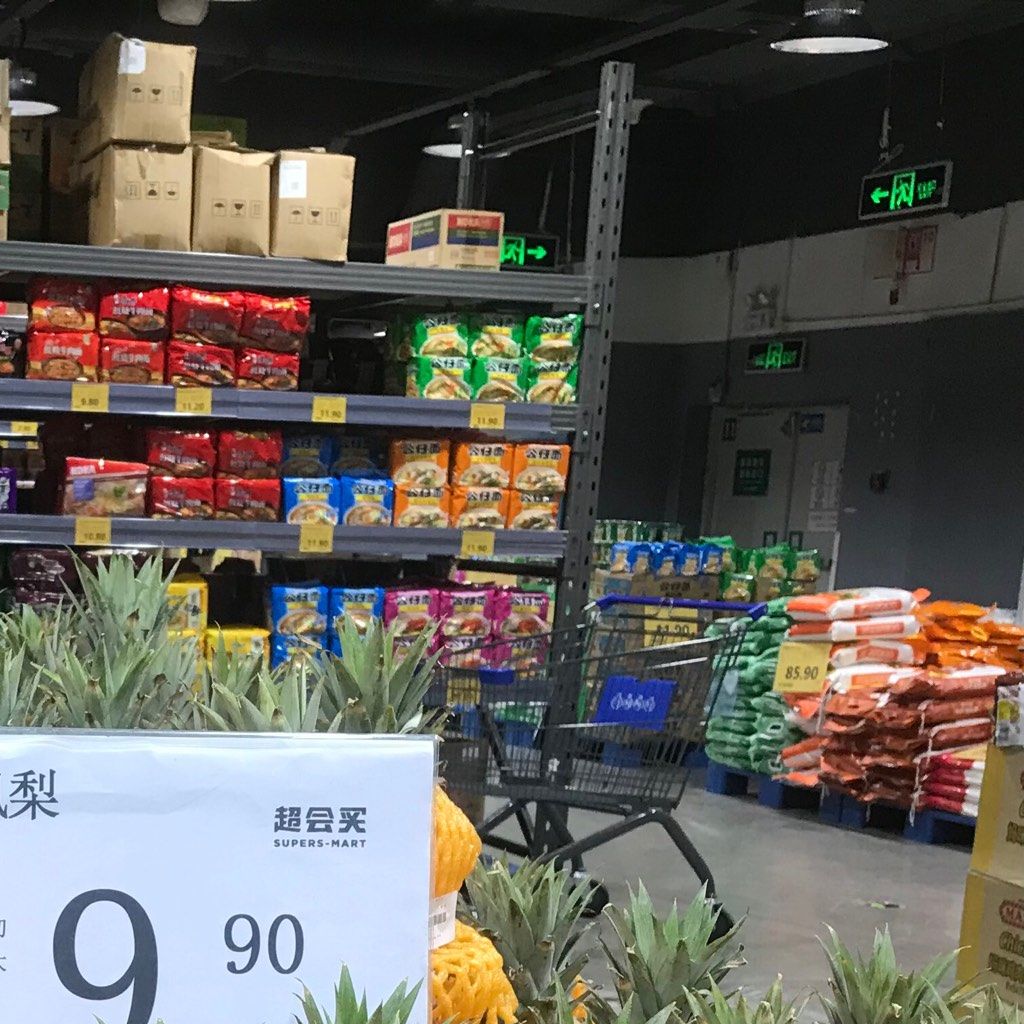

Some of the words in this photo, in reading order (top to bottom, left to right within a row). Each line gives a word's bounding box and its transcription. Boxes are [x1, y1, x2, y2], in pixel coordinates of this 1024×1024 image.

[784, 665, 820, 681] 85.90
[273, 806, 368, 834] 超会买
[273, 838, 367, 848] SUPERS-MART
[223, 913, 305, 975] 90
